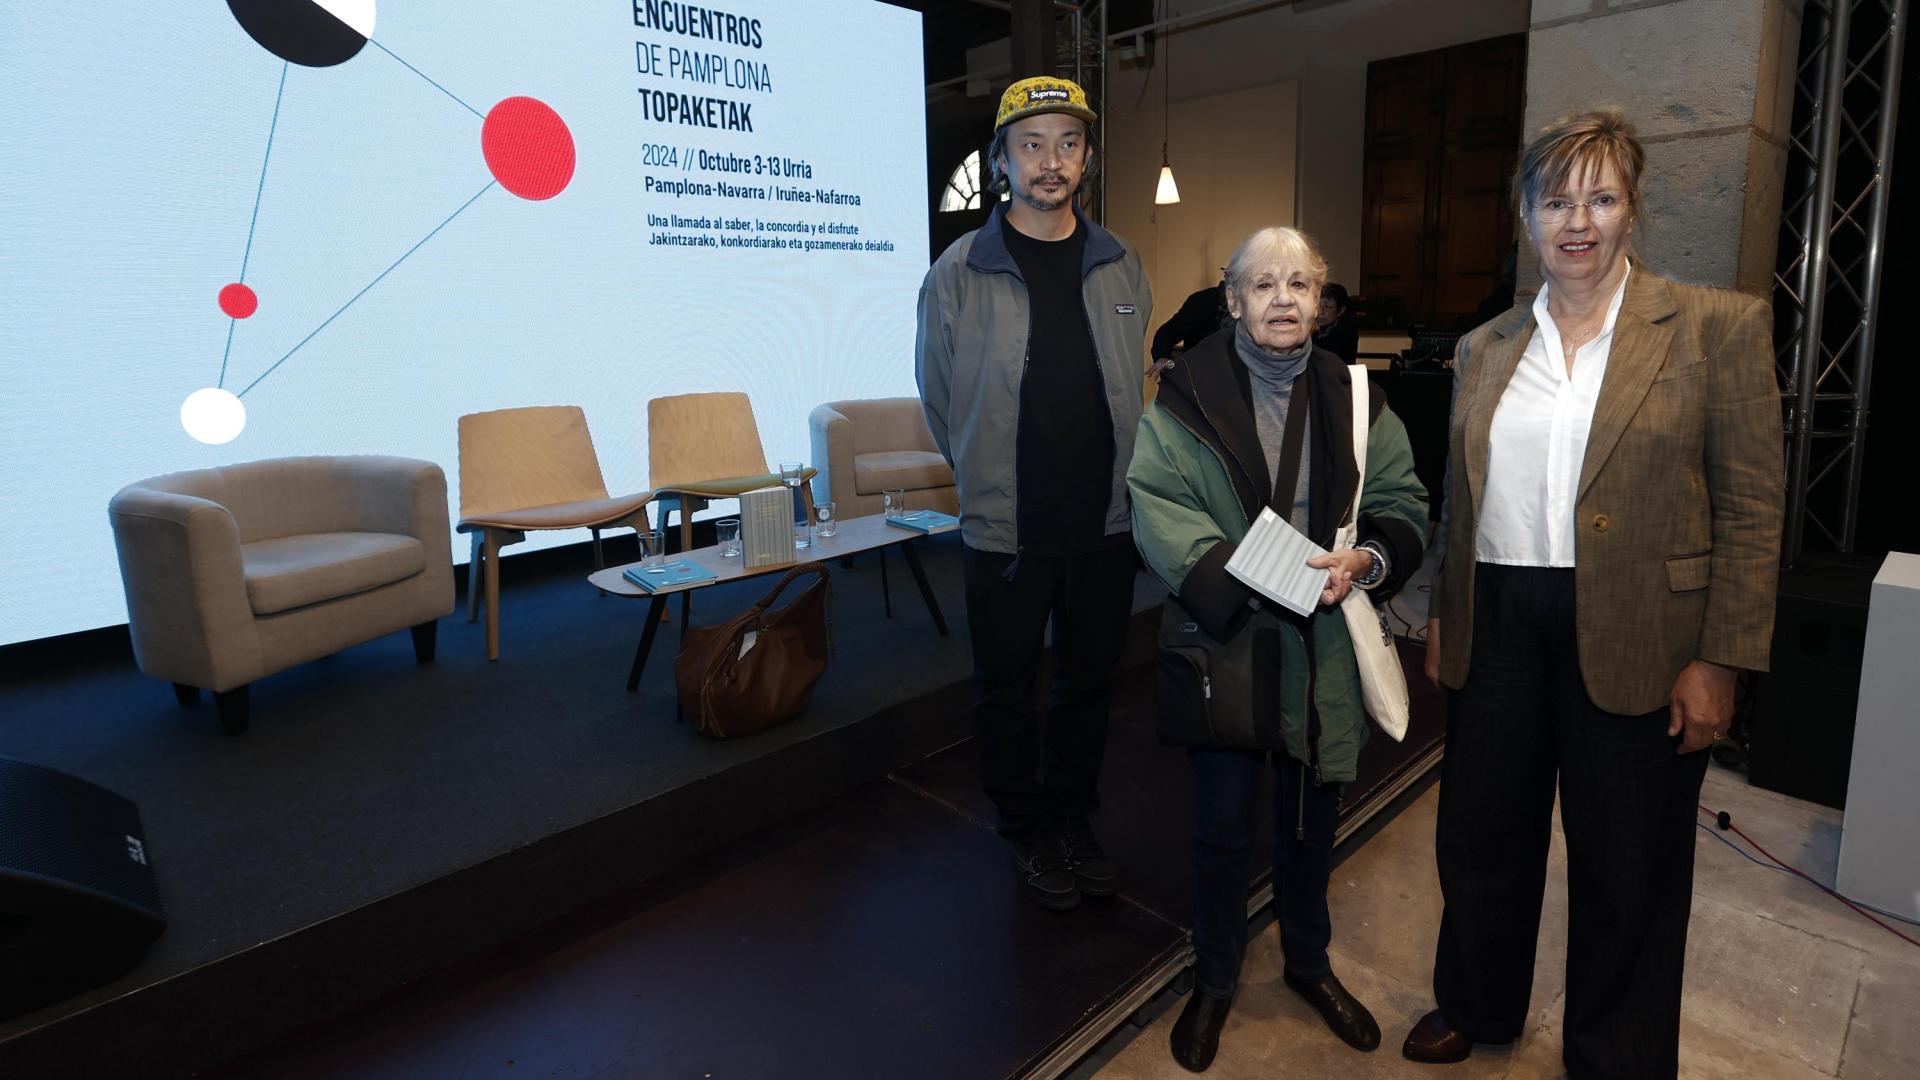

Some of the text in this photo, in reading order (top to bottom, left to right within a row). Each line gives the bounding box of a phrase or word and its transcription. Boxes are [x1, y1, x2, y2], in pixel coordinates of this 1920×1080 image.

[632, 0, 763, 49] ENCUENTROS
[636, 41, 772, 93] DE PAMPLONA
[638, 88, 753, 132] TOPAKETAK
[1030, 91, 1067, 99] Supreme
[642, 144, 812, 179] 2024 // Octubre 3-13 Urria
[645, 176, 861, 206] Pamplona-Navarra / Iruñea-Nafarroa
[648, 214, 859, 236] Una llamada al saber, la concordia y el disfrute
[649, 233, 894, 252] Jakintzarako, konkordiarako eta gozamenerako deialdia
